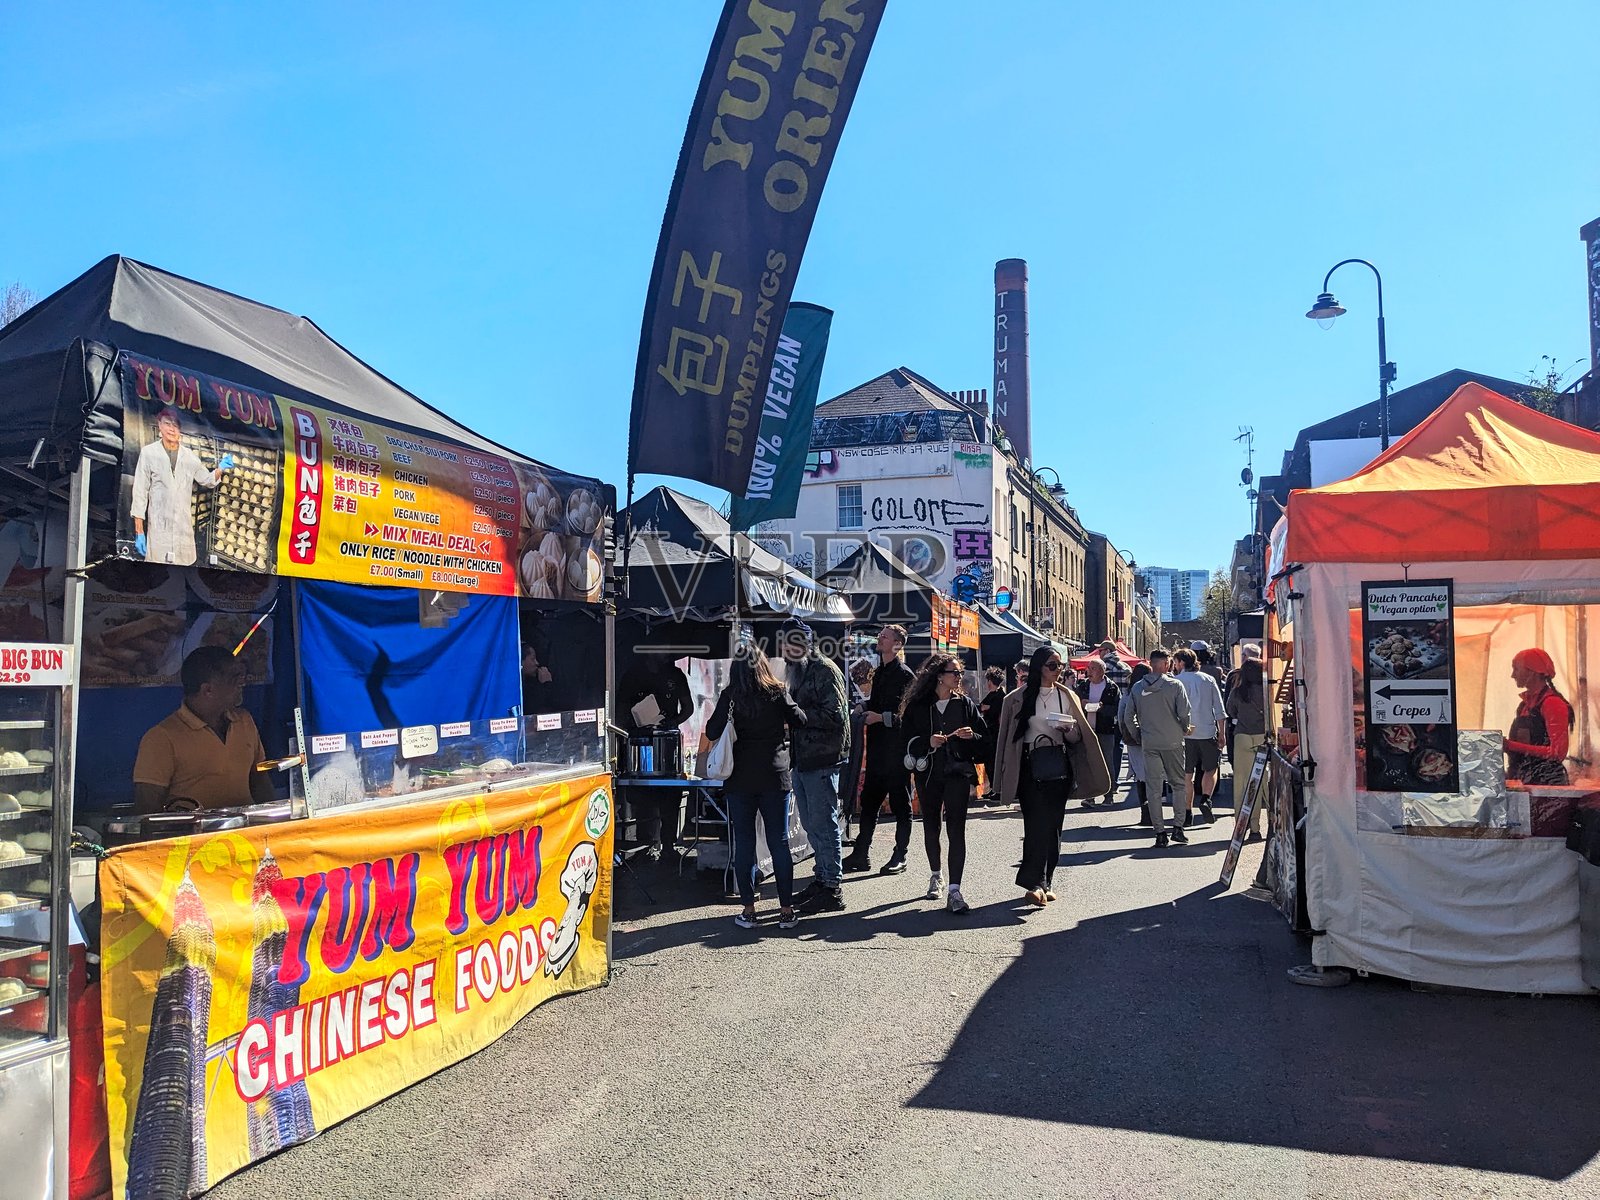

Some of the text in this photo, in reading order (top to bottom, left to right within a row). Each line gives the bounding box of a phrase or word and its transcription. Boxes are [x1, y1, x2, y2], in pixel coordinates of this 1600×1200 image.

[703, 0, 796, 171] YUM
[657, 250, 743, 396] 包子
[725, 249, 787, 456] DUMPLINGS
[997, 291, 1008, 425] TRUMAN
[762, 334, 802, 420] VEGAN
[128, 357, 277, 431] YUM YUM
[296, 412, 318, 494] BUN
[333, 436, 380, 459] 牛肉包子
[333, 455, 381, 477] 鸡肉包子
[392, 452, 411, 464] BEEF
[495, 477, 513, 488] piece
[745, 434, 783, 500] 100%
[334, 475, 380, 498] 猪肉包子
[394, 470, 429, 485] CHICKEN
[474, 487, 493, 500] £2.50
[497, 493, 515, 504] piece
[333, 495, 357, 514] 菜包
[394, 489, 415, 502] PORK
[474, 504, 493, 518] £2.50
[497, 510, 515, 521] piece
[383, 525, 477, 553] MIX MEAL DEAL
[472, 522, 490, 534] £2.50
[495, 526, 513, 537] piece
[340, 543, 369, 557] ONLY
[372, 549, 395, 560] RICE
[403, 551, 440, 566] NOODLE
[444, 556, 465, 569] WITH
[467, 559, 502, 574] CHICKEN
[1369, 593, 1447, 603] Dutch Pancakes
[1380, 605, 1436, 615] Vegan option
[1, 649, 63, 670] BIG BUN
[1393, 704, 1431, 718] Crepes
[572, 856, 586, 871] YUM
[272, 825, 542, 989] YUM YUM
[234, 917, 557, 1103] CHINESE FOODS
